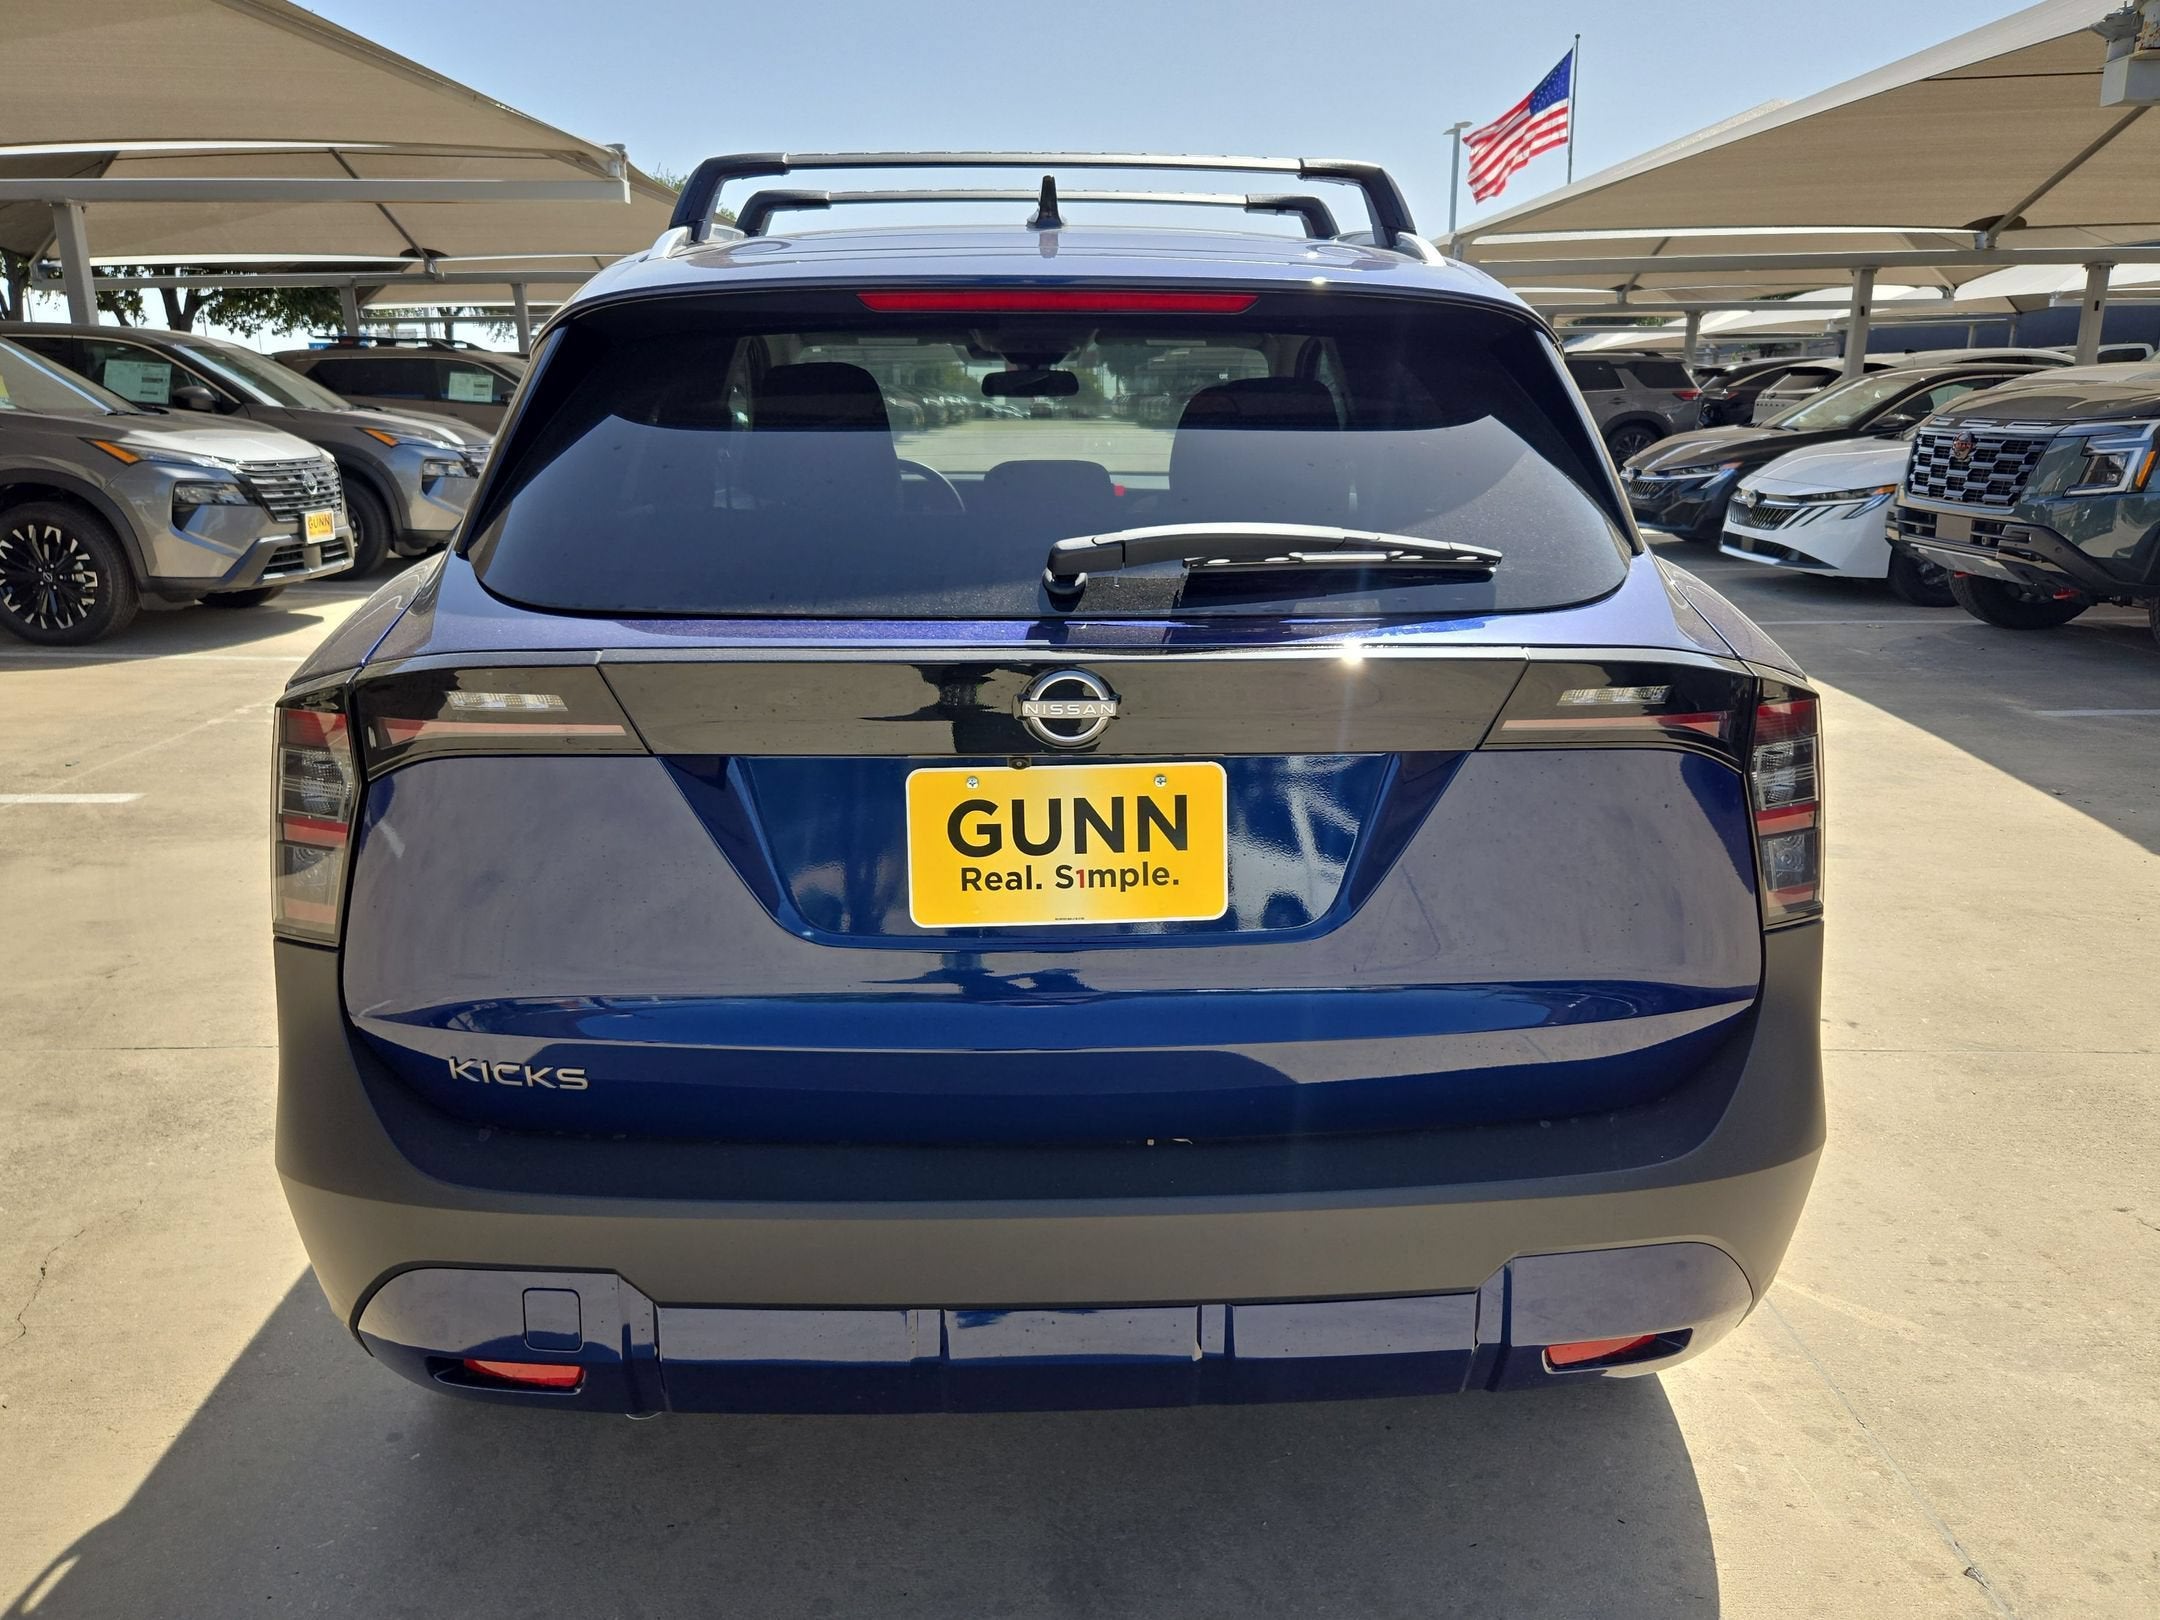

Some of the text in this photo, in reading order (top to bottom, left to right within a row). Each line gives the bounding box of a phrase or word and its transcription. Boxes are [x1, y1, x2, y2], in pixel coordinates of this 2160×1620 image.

[308, 515, 330, 529] GUNN
[1024, 703, 1116, 716] NISSAN
[947, 795, 1188, 857] GUNN
[961, 862, 1179, 892] Real. S1mple.
[448, 1056, 589, 1090] KICKS
